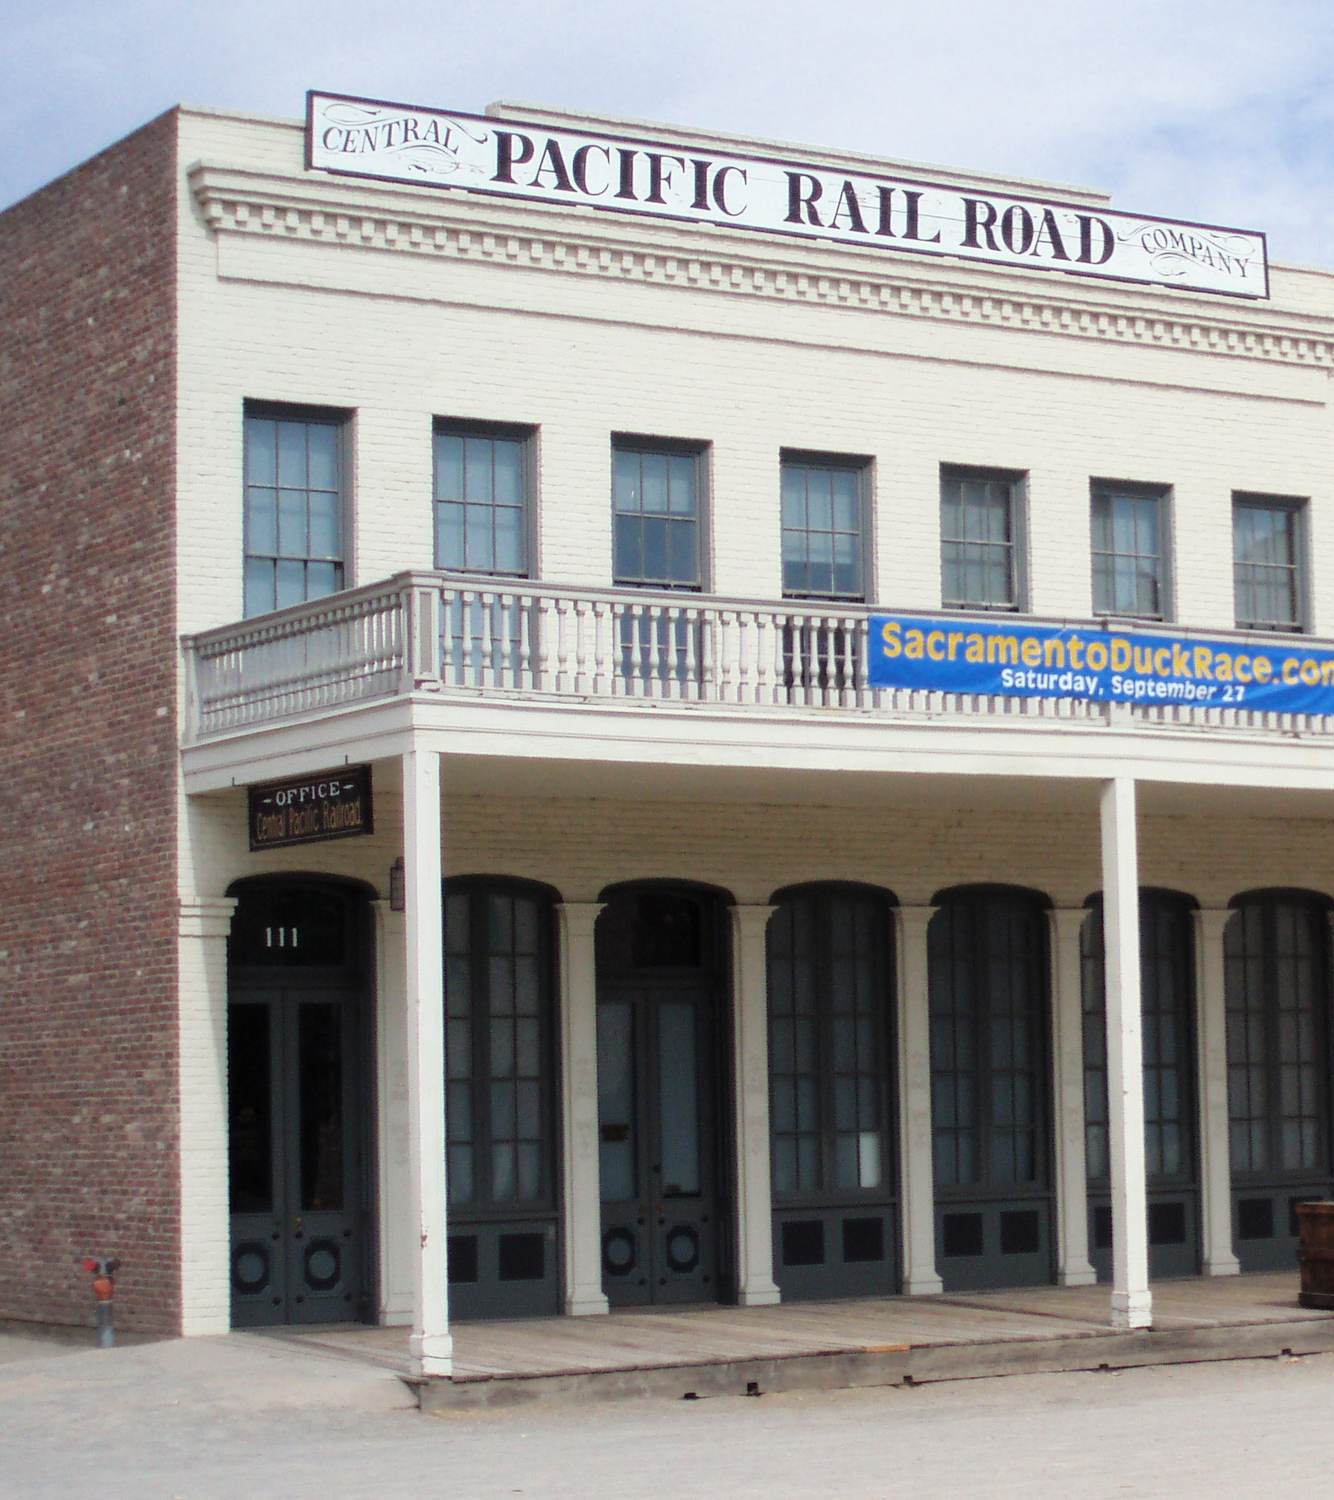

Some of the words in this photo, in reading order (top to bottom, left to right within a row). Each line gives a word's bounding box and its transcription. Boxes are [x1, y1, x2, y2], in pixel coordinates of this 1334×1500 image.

[322, 117, 460, 155] CENTRAL
[489, 130, 748, 217] PACIFIC
[783, 171, 941, 244] RAIL
[960, 197, 1115, 265] ROAD
[1141, 228, 1249, 278] COMPANY
[1002, 668, 1105, 697] Saturday,
[1112, 675, 1217, 704] September
[1222, 685, 1246, 702] 27
[265, 927, 298, 948] 111
